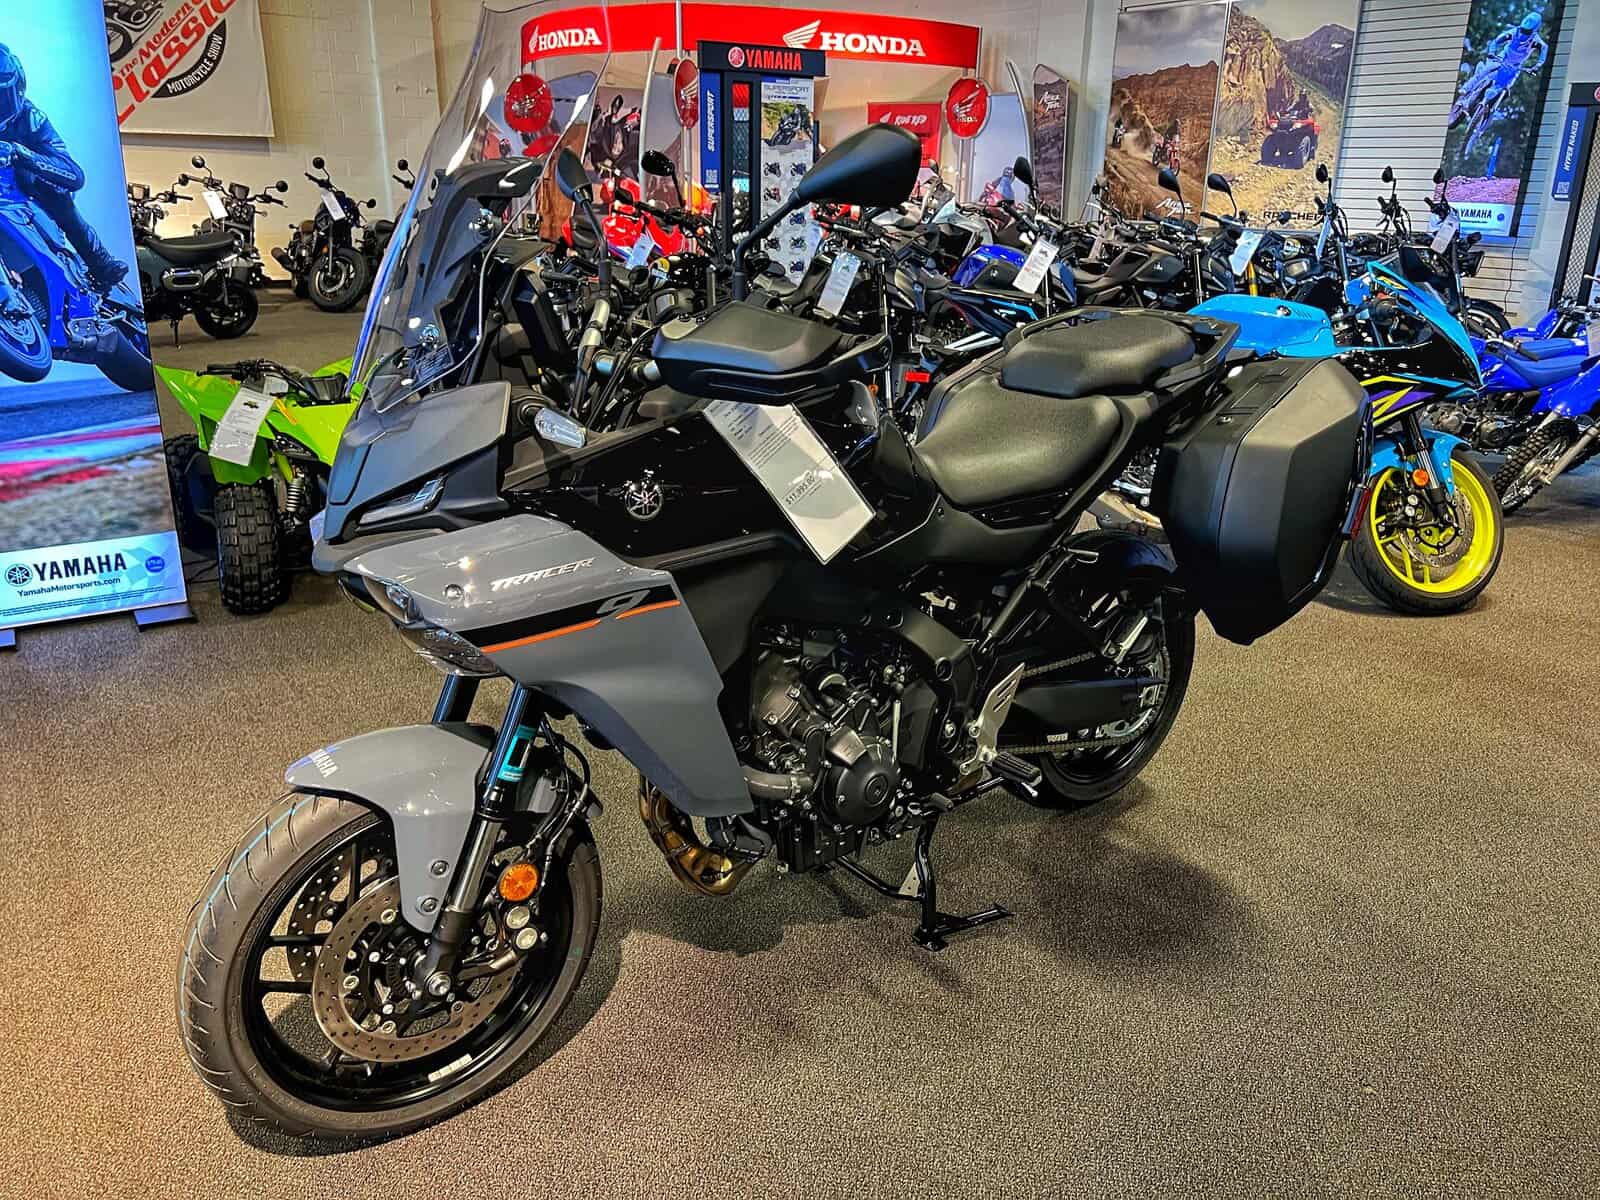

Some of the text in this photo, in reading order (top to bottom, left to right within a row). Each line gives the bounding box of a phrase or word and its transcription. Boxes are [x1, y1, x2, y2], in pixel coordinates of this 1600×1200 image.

[120, 2, 195, 76] The Modern
[538, 27, 603, 51] HONDA
[820, 32, 926, 57] HONDA
[166, 34, 224, 94] MOTORCYCLE SHOW
[745, 49, 802, 70] YAMAHA
[706, 90, 716, 152] SUPERSPORT
[1563, 120, 1579, 172] HYPER NAKED
[1460, 209, 1492, 219] YAMAHA
[34, 552, 127, 581] YAMAHA
[490, 558, 596, 592] TRACER
[17, 577, 121, 597] YamahaMotorsports.com
